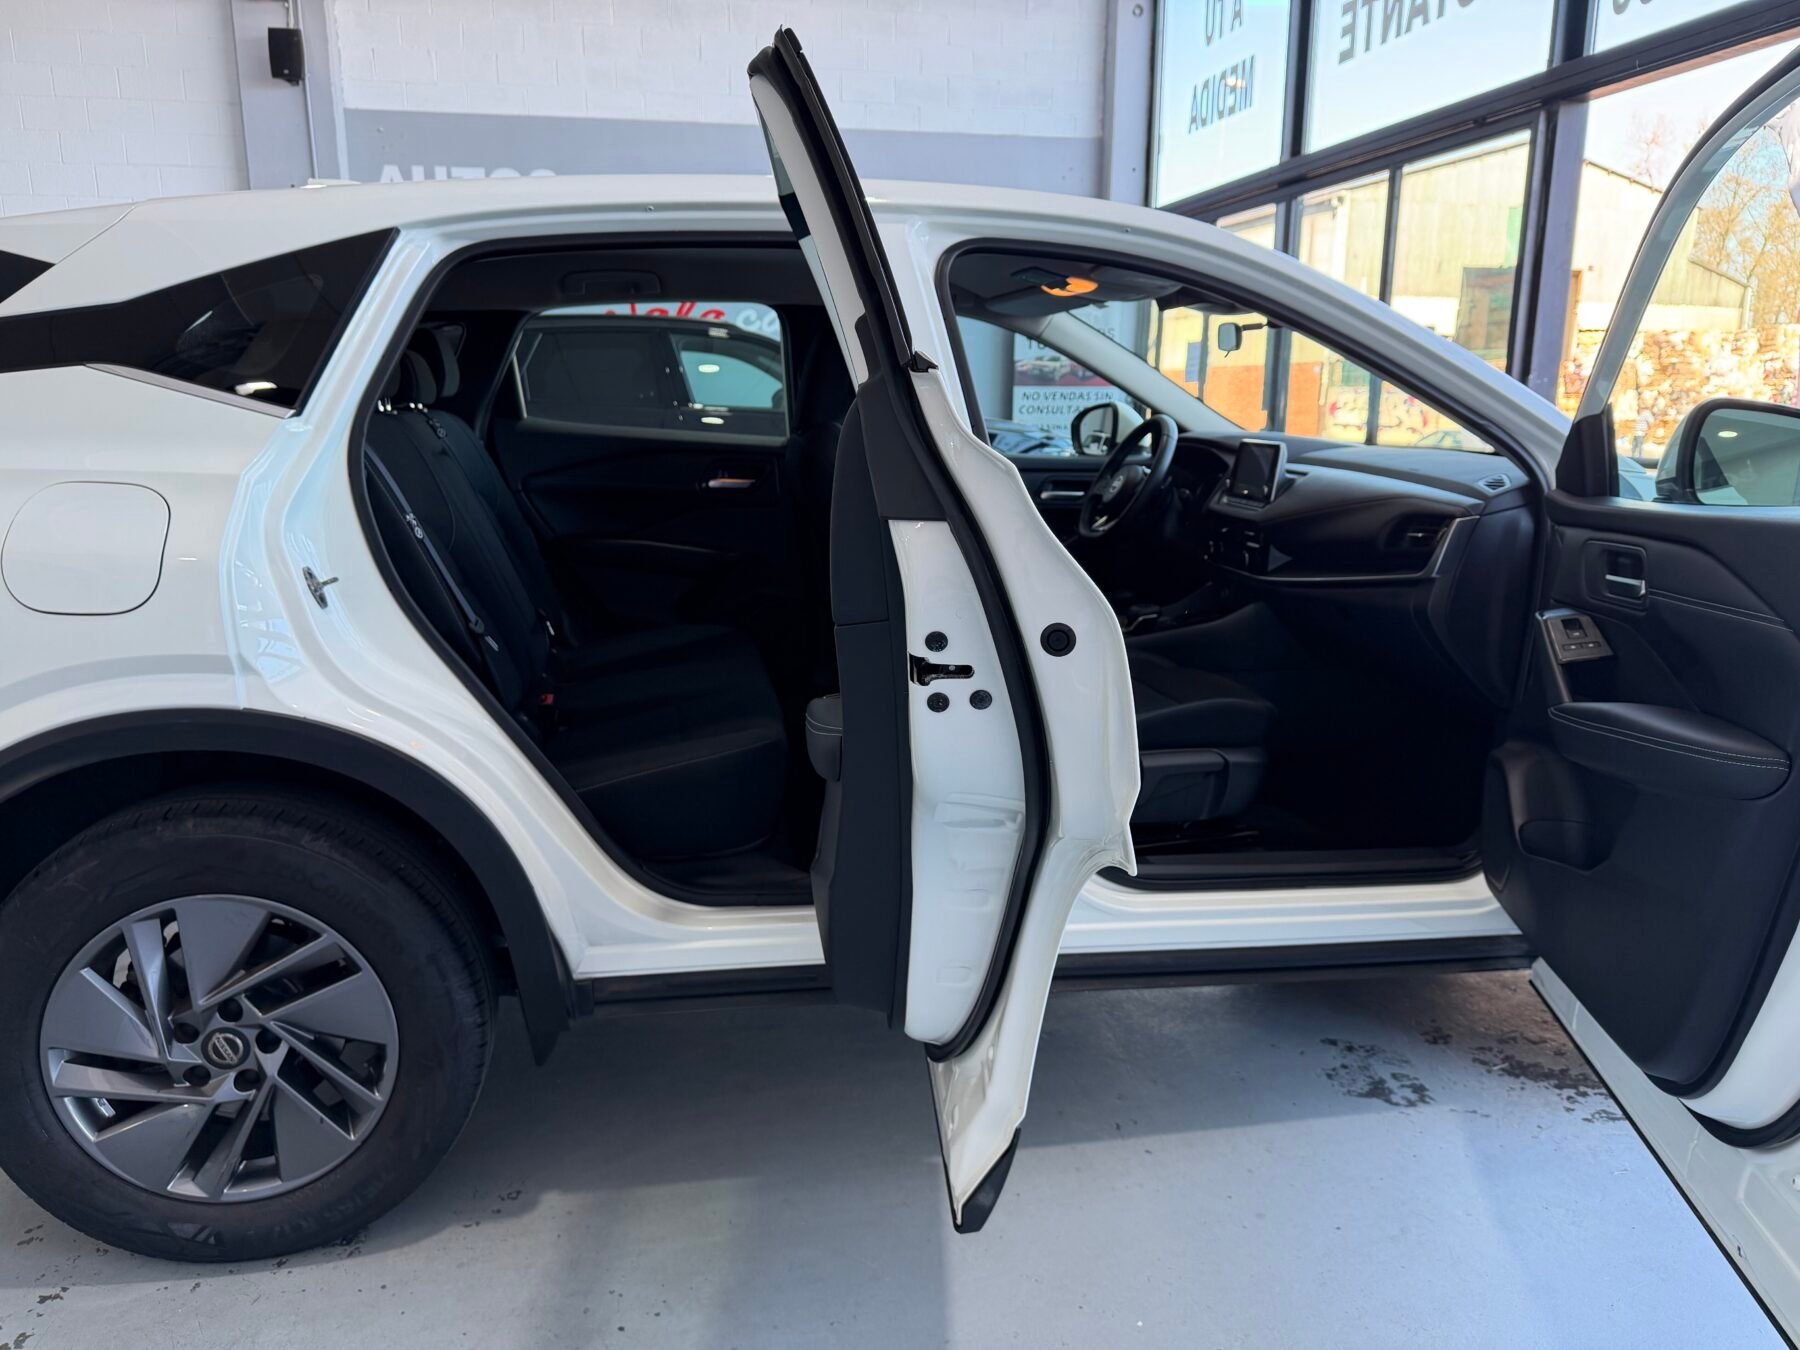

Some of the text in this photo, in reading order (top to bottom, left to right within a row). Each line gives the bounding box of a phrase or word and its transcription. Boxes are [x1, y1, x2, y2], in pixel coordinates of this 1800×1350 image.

[1022, 391, 1114, 401] NO VENDAS SIN
